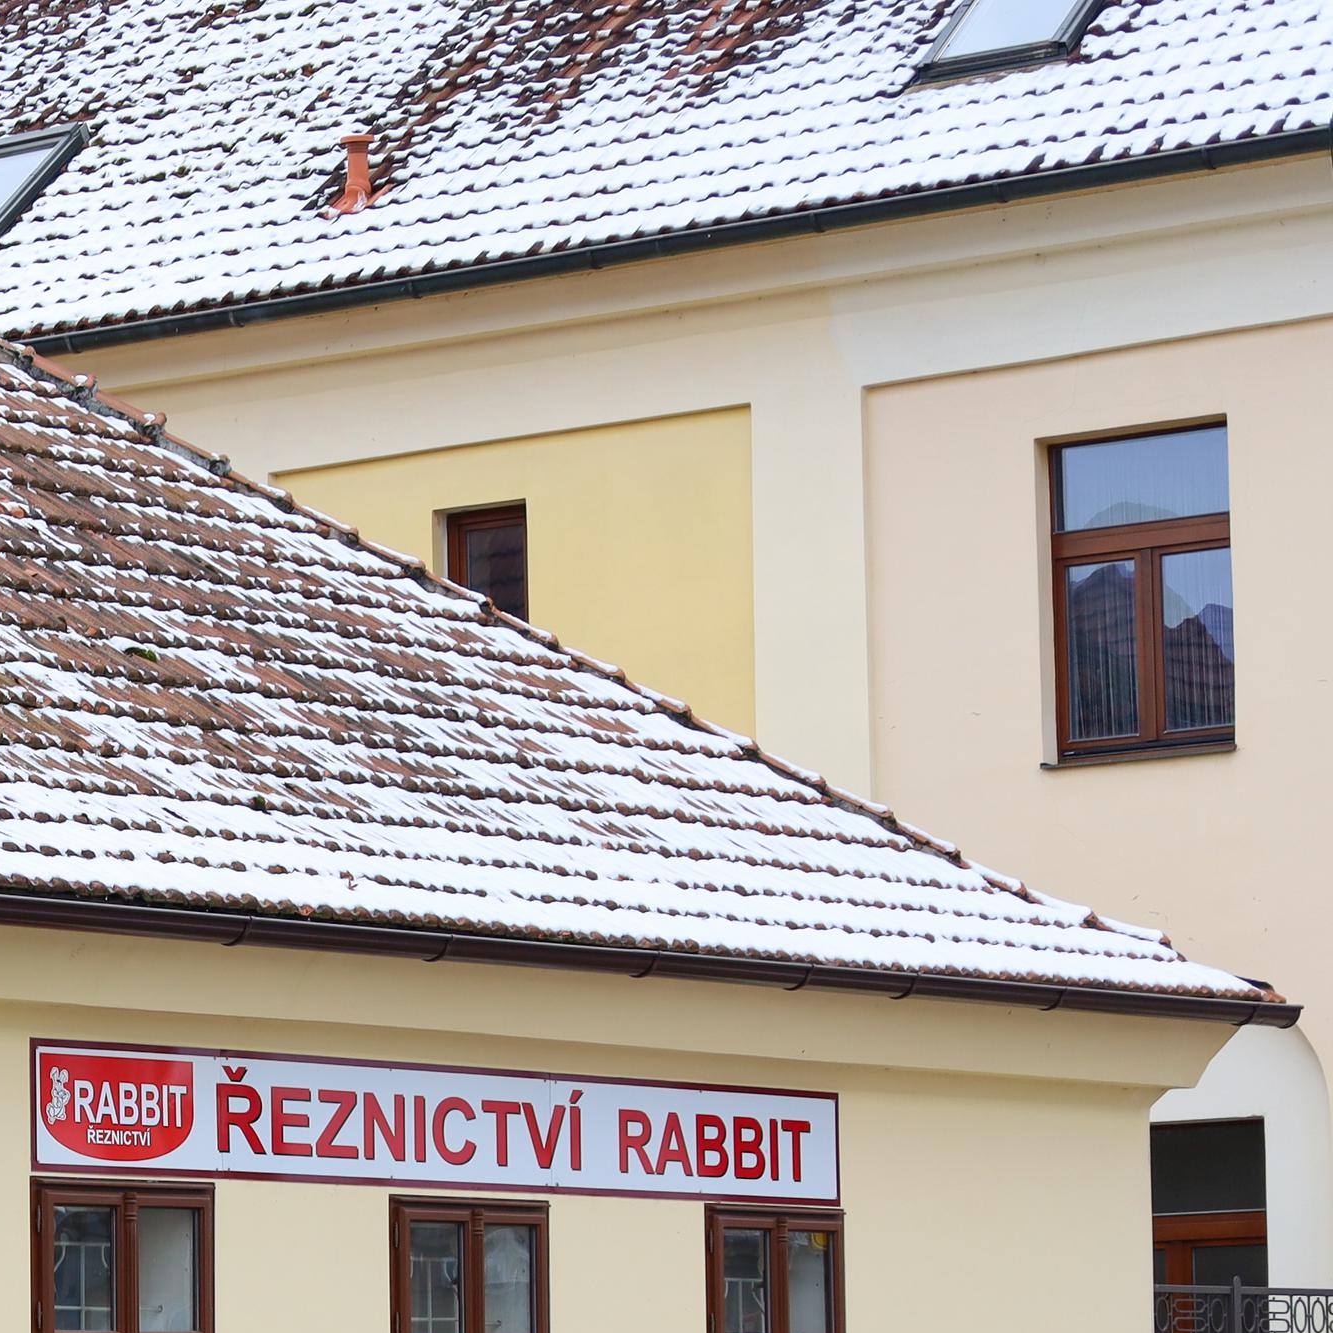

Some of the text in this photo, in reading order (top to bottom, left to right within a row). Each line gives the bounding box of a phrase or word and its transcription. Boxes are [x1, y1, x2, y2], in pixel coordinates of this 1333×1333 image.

[74, 1079, 188, 1128] RABBIT
[216, 1066, 811, 1183] ŘEZNICTVÍ RABBIT
[87, 1125, 151, 1146] ŘEZNICTVÍ
